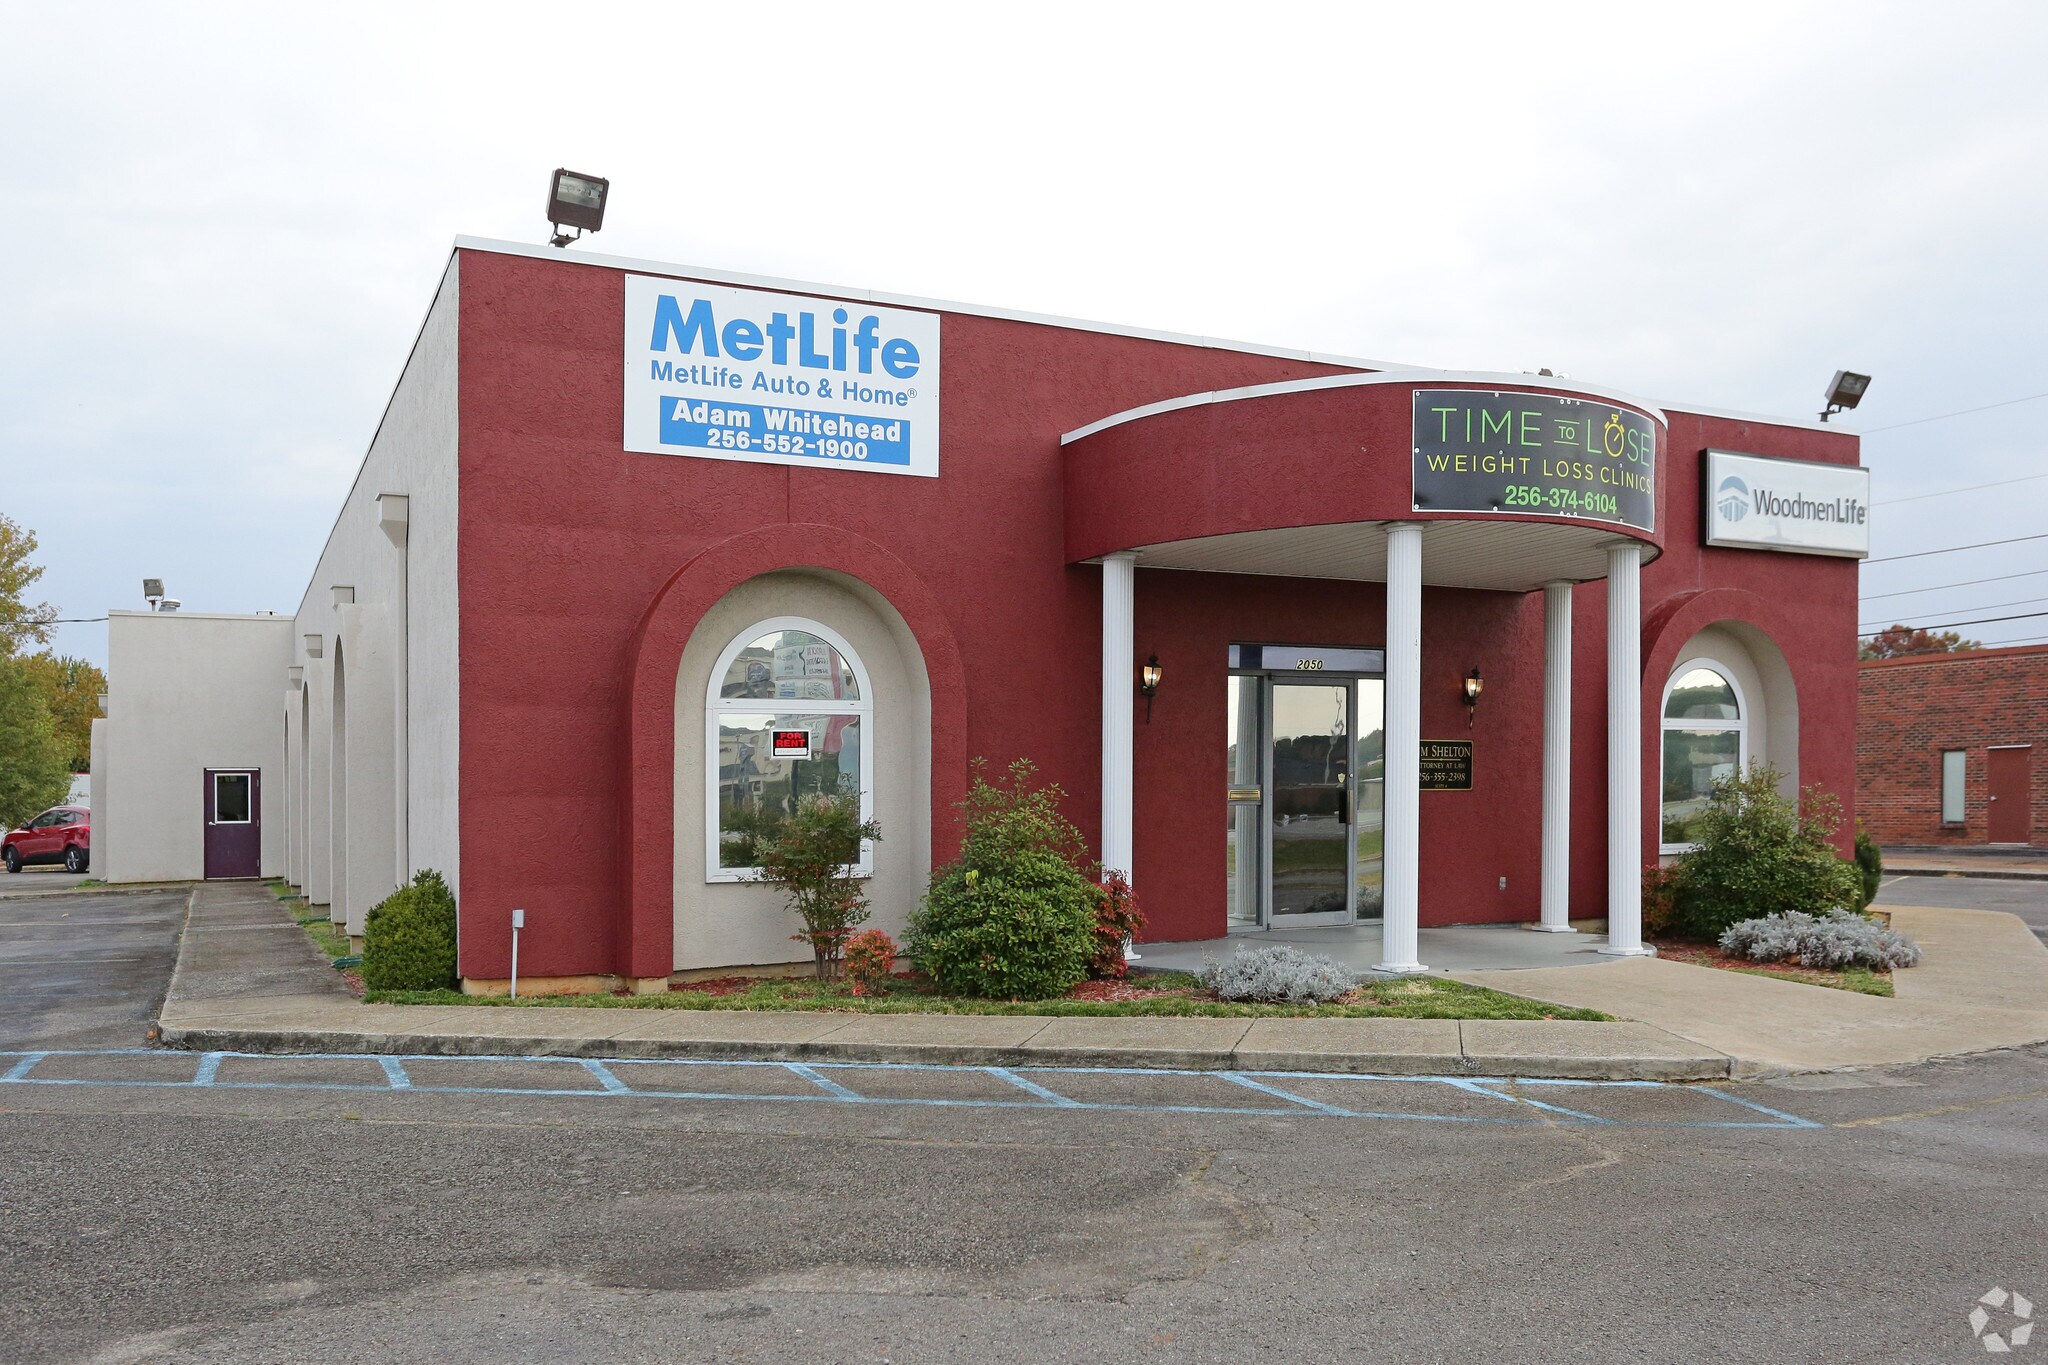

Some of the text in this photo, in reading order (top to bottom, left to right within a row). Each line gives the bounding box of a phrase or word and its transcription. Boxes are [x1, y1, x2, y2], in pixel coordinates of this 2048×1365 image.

[650, 294, 920, 379] MetLife
[651, 360, 743, 389] MetLife
[752, 371, 810, 396] Auto
[817, 378, 833, 399] &
[671, 399, 901, 442] Adam Whitehead
[1431, 407, 1651, 467] TIME TO LOSE
[707, 428, 868, 460] 256-552-1900
[1427, 454, 1652, 495] WEIGHT LOSS CLINICS
[1505, 485, 1618, 514] 256-374-6104
[1754, 488, 1866, 525] WoodmenLife
[1296, 659, 1323, 670] 2050
[775, 739, 805, 748] RENT
[780, 732, 802, 740] FOR
[1431, 745, 1471, 757] SHELTON
